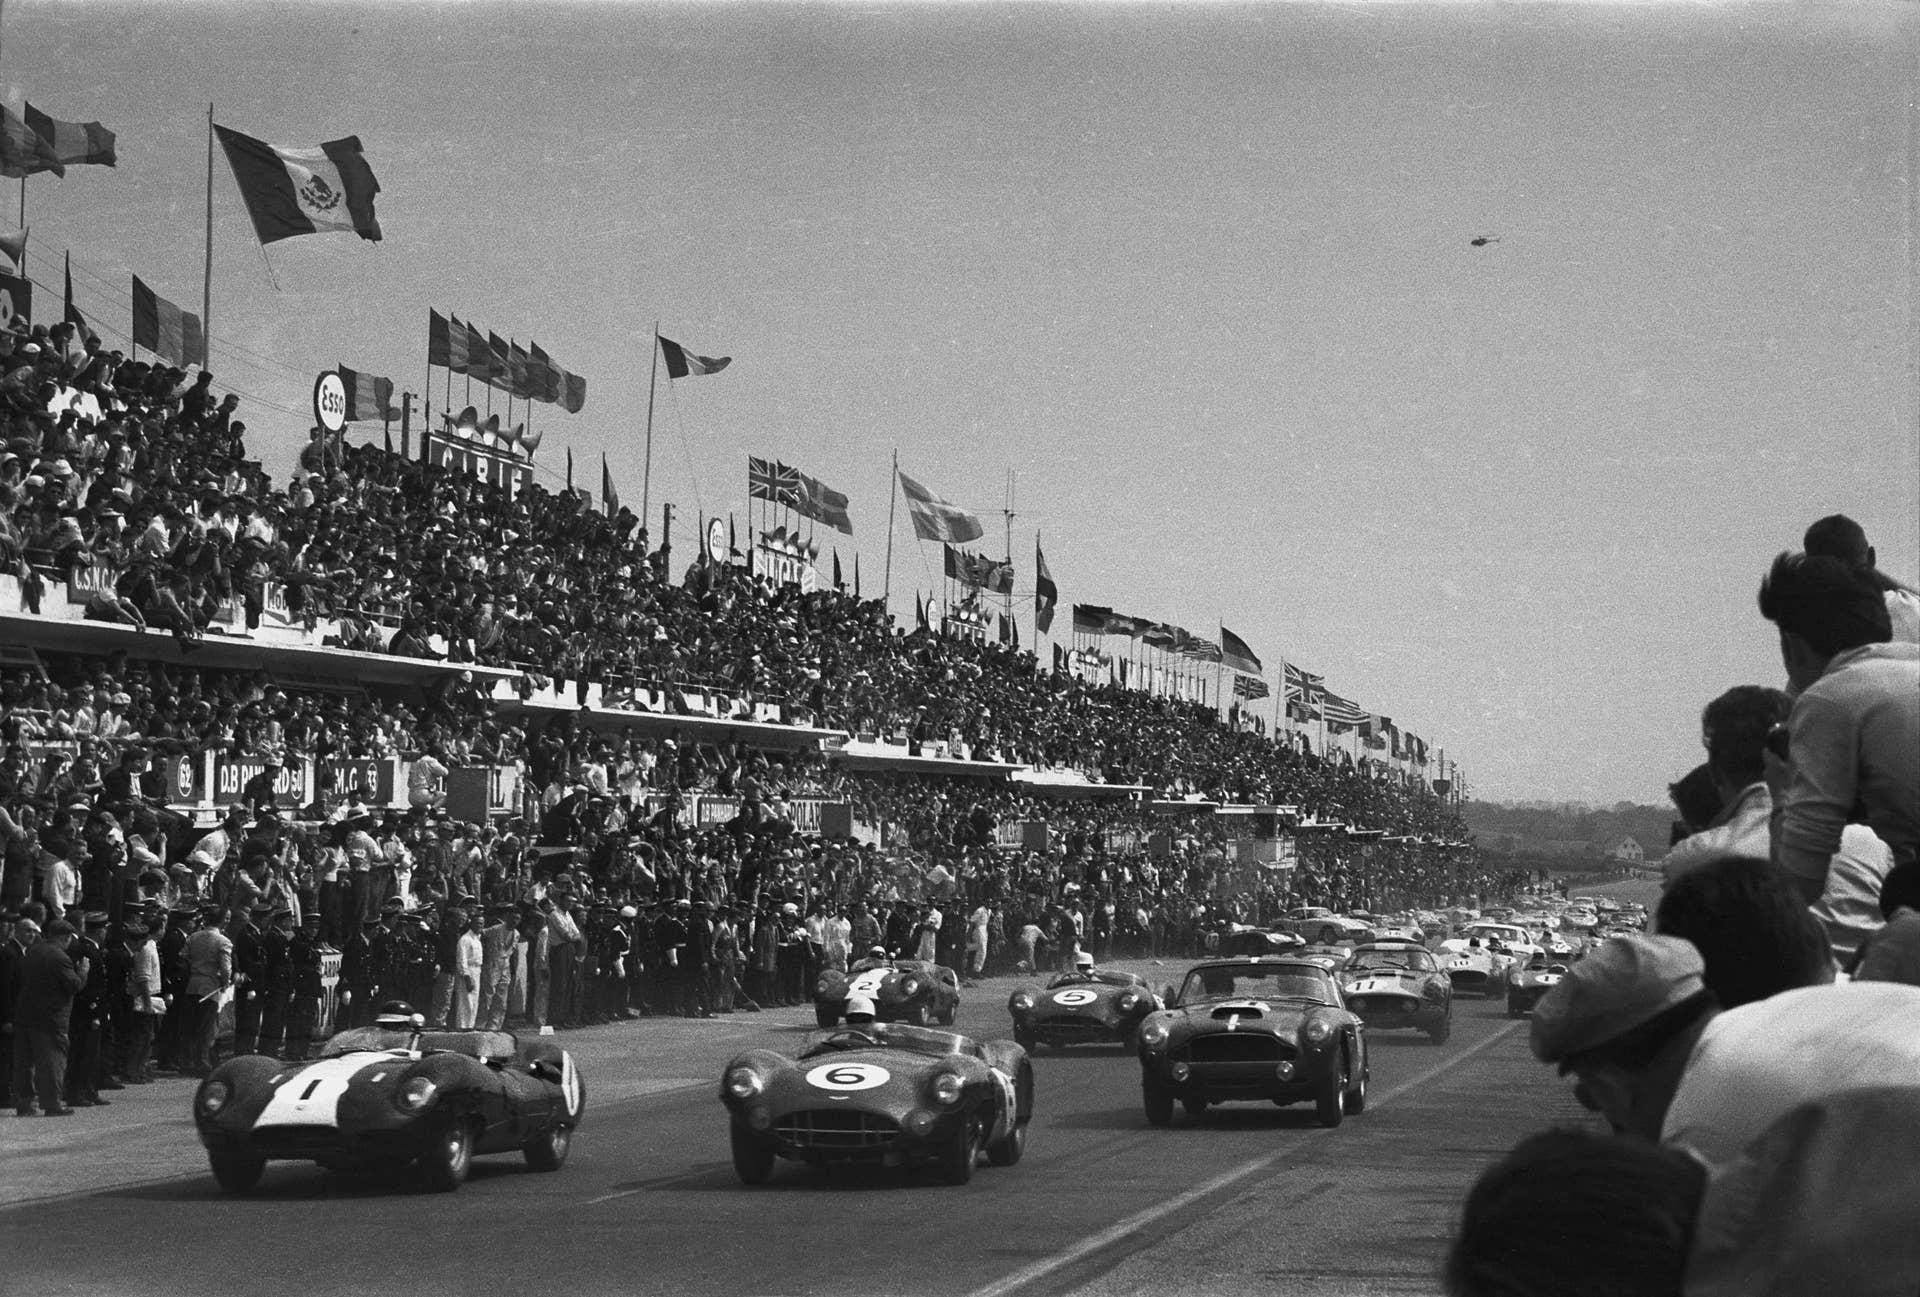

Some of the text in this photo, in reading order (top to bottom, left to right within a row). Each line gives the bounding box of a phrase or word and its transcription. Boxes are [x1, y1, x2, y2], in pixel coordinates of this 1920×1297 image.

[858, 981, 872, 991] 2
[1355, 981, 1375, 991] 11
[1063, 991, 1085, 1002] 5
[825, 1066, 865, 1085] 6
[300, 1079, 323, 1100] 1
